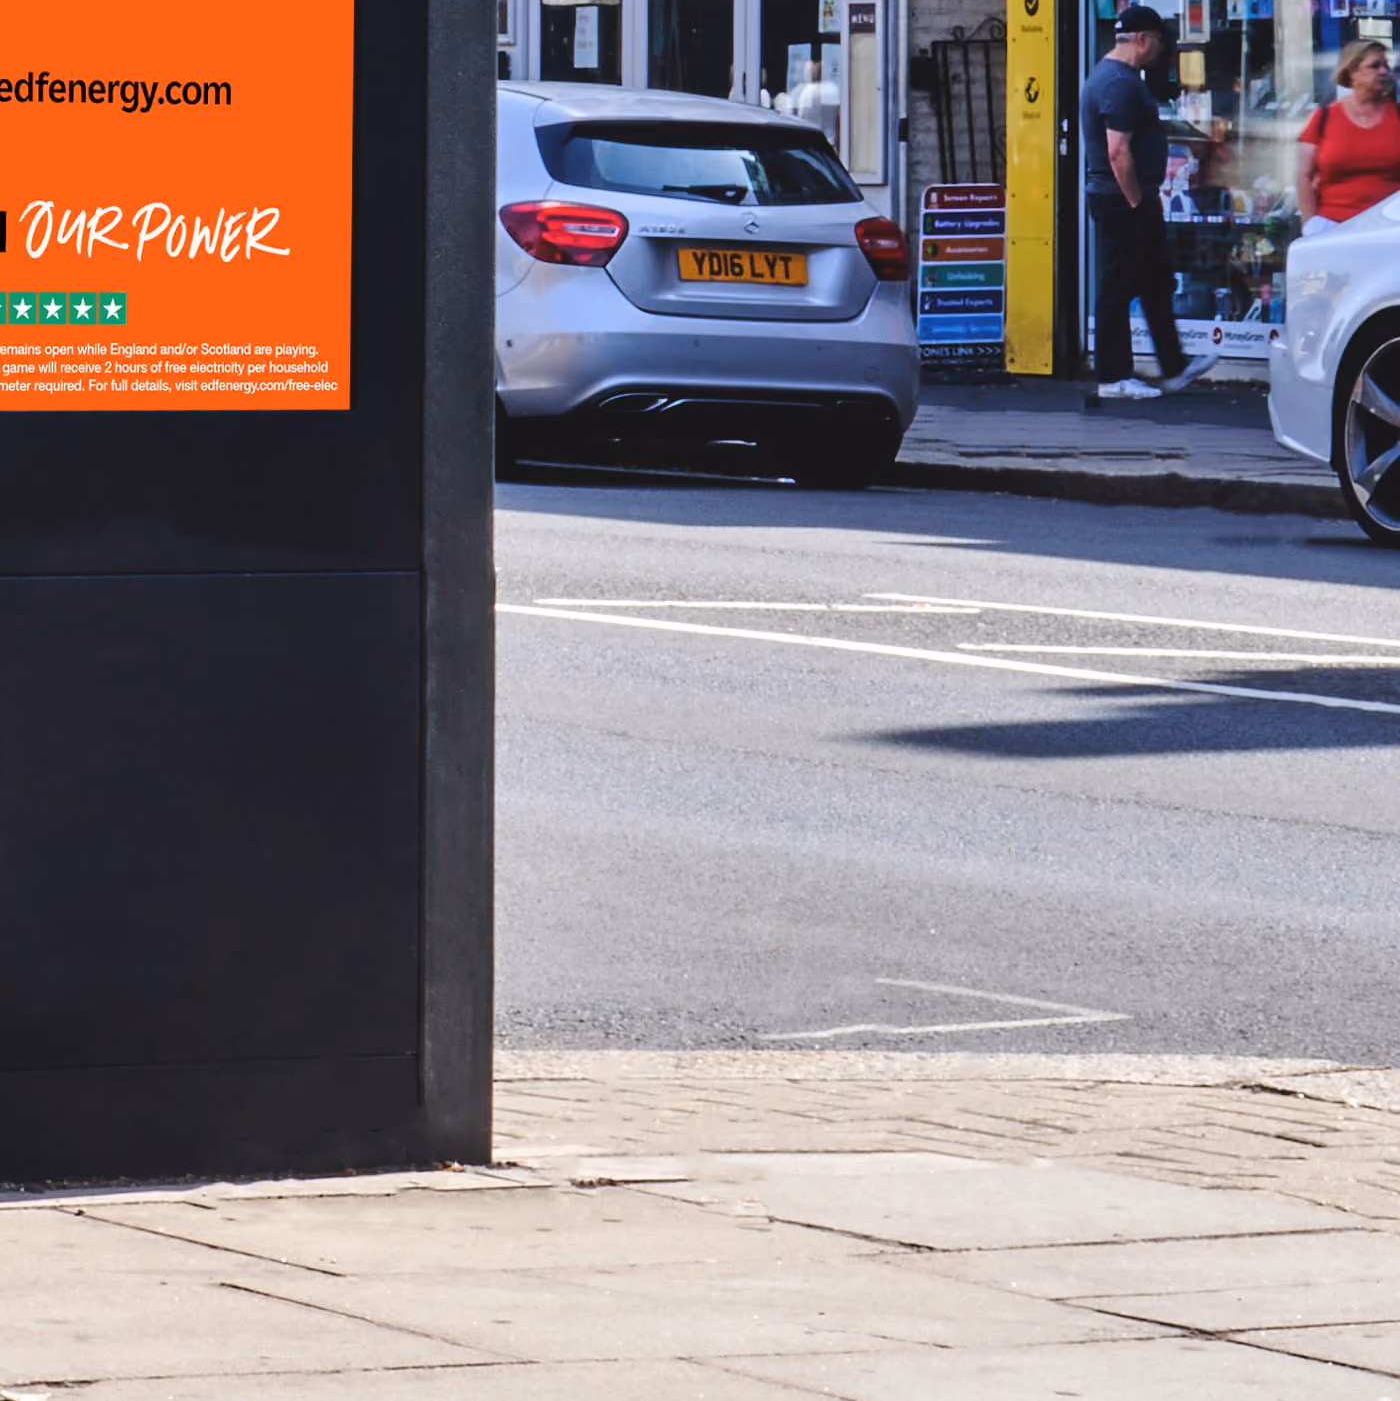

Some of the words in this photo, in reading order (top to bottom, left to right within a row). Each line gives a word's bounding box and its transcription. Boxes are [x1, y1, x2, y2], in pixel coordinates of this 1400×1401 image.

[19, 200, 130, 261] OUR
[132, 202, 290, 263] POWER
[692, 252, 744, 276] YD16
[750, 255, 792, 279] LYT
[45, 346, 74, 358] open
[78, 343, 107, 355] while
[111, 343, 157, 358] England
[160, 343, 198, 355] and/or
[201, 343, 252, 355] Scotland
[255, 346, 272, 355] are
[275, 344, 320, 358] playing.
[3, 364, 35, 376] game
[39, 361, 57, 373] will
[61, 362, 102, 373] receive
[105, 361, 112, 373] 2
[115, 361, 148, 373] hours
[151, 361, 163, 373] of
[165, 361, 187, 373] free
[190, 361, 245, 375] electricity
[248, 364, 266, 375] per
[269, 361, 329, 373] household
[34, 379, 86, 394] required.
[89, 379, 109, 391] For
[111, 379, 128, 391] full
[131, 379, 172, 391] details,
[175, 380, 198, 391] visit
[201, 379, 338, 394] edfenergy.com/free-elec
